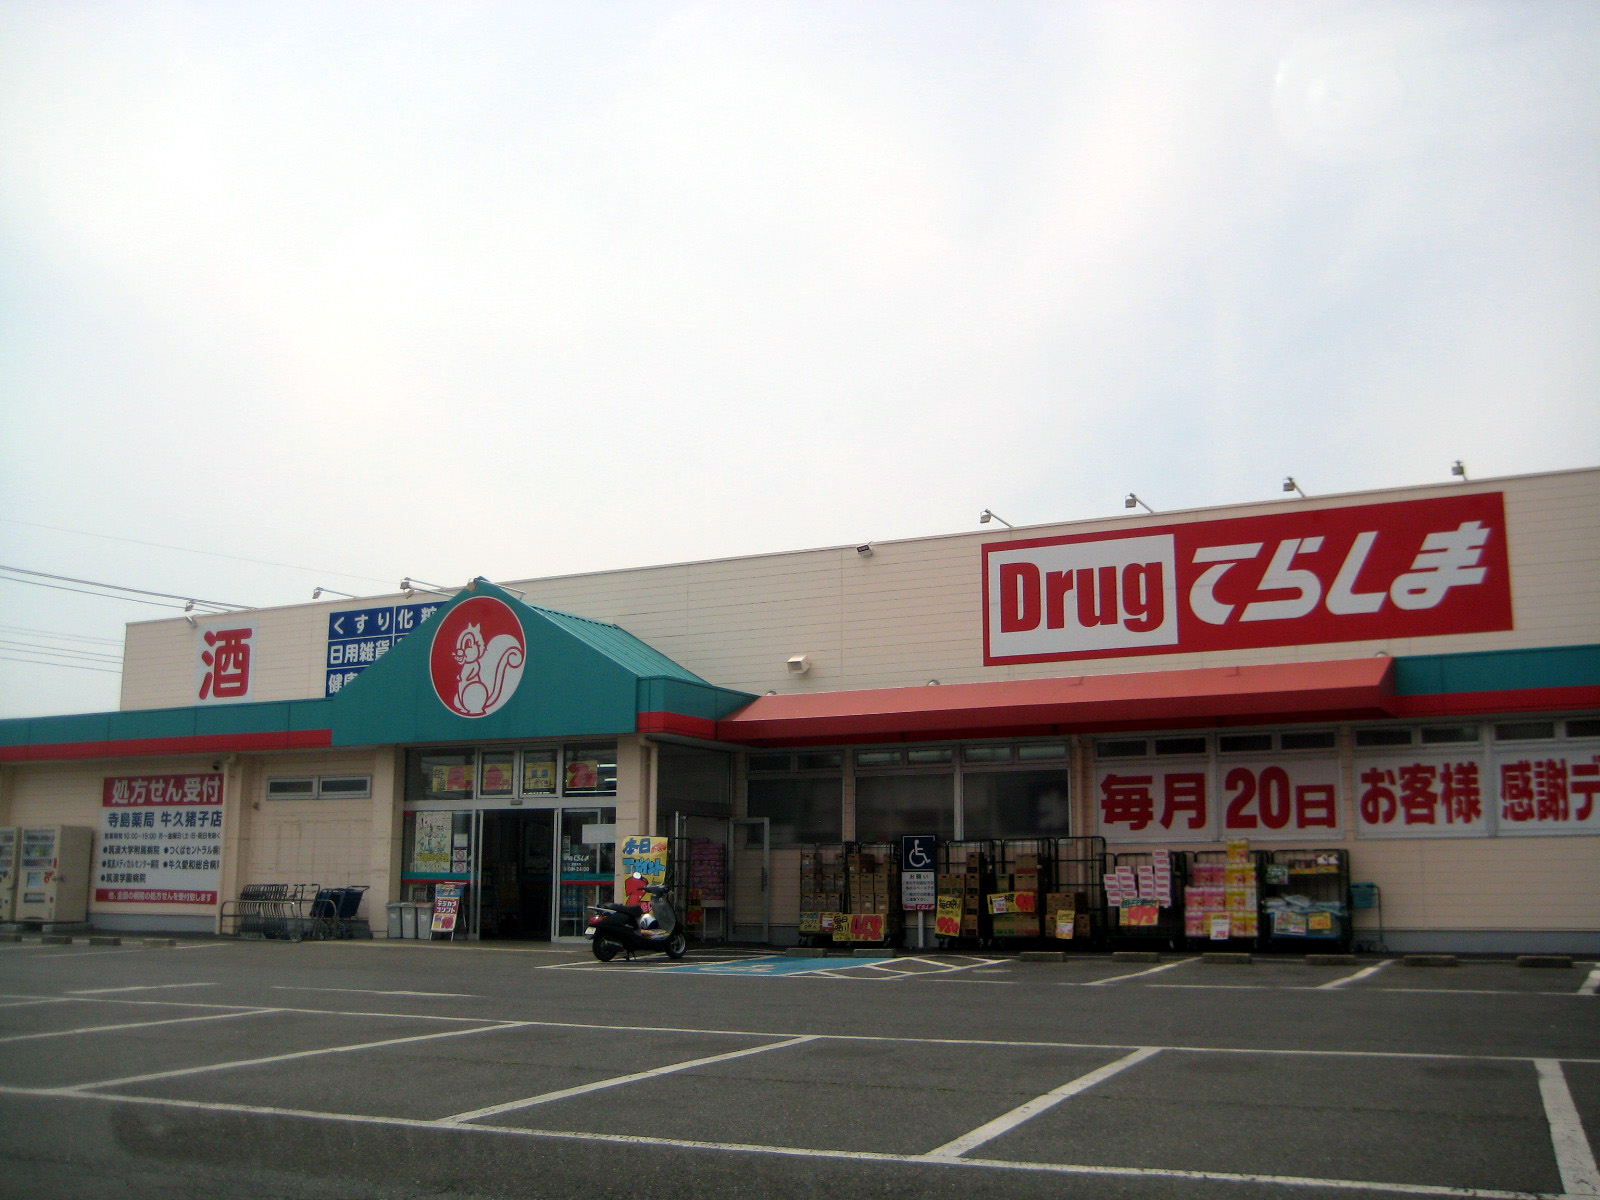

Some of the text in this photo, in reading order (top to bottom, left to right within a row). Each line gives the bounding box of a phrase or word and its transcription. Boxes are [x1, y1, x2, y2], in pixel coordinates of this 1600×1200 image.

[1000, 520, 1491, 634] Drug てらしま
[334, 612, 390, 635] くすり
[199, 628, 253, 700] 酒
[330, 640, 390, 664] 日用雑貨
[112, 776, 221, 804] 処方せん受付
[1100, 772, 1207, 831] 毎月
[1225, 766, 1337, 830] 20日
[1360, 761, 1481, 826] お客様
[108, 810, 223, 828] 寺島薬局 牛久猪子店
